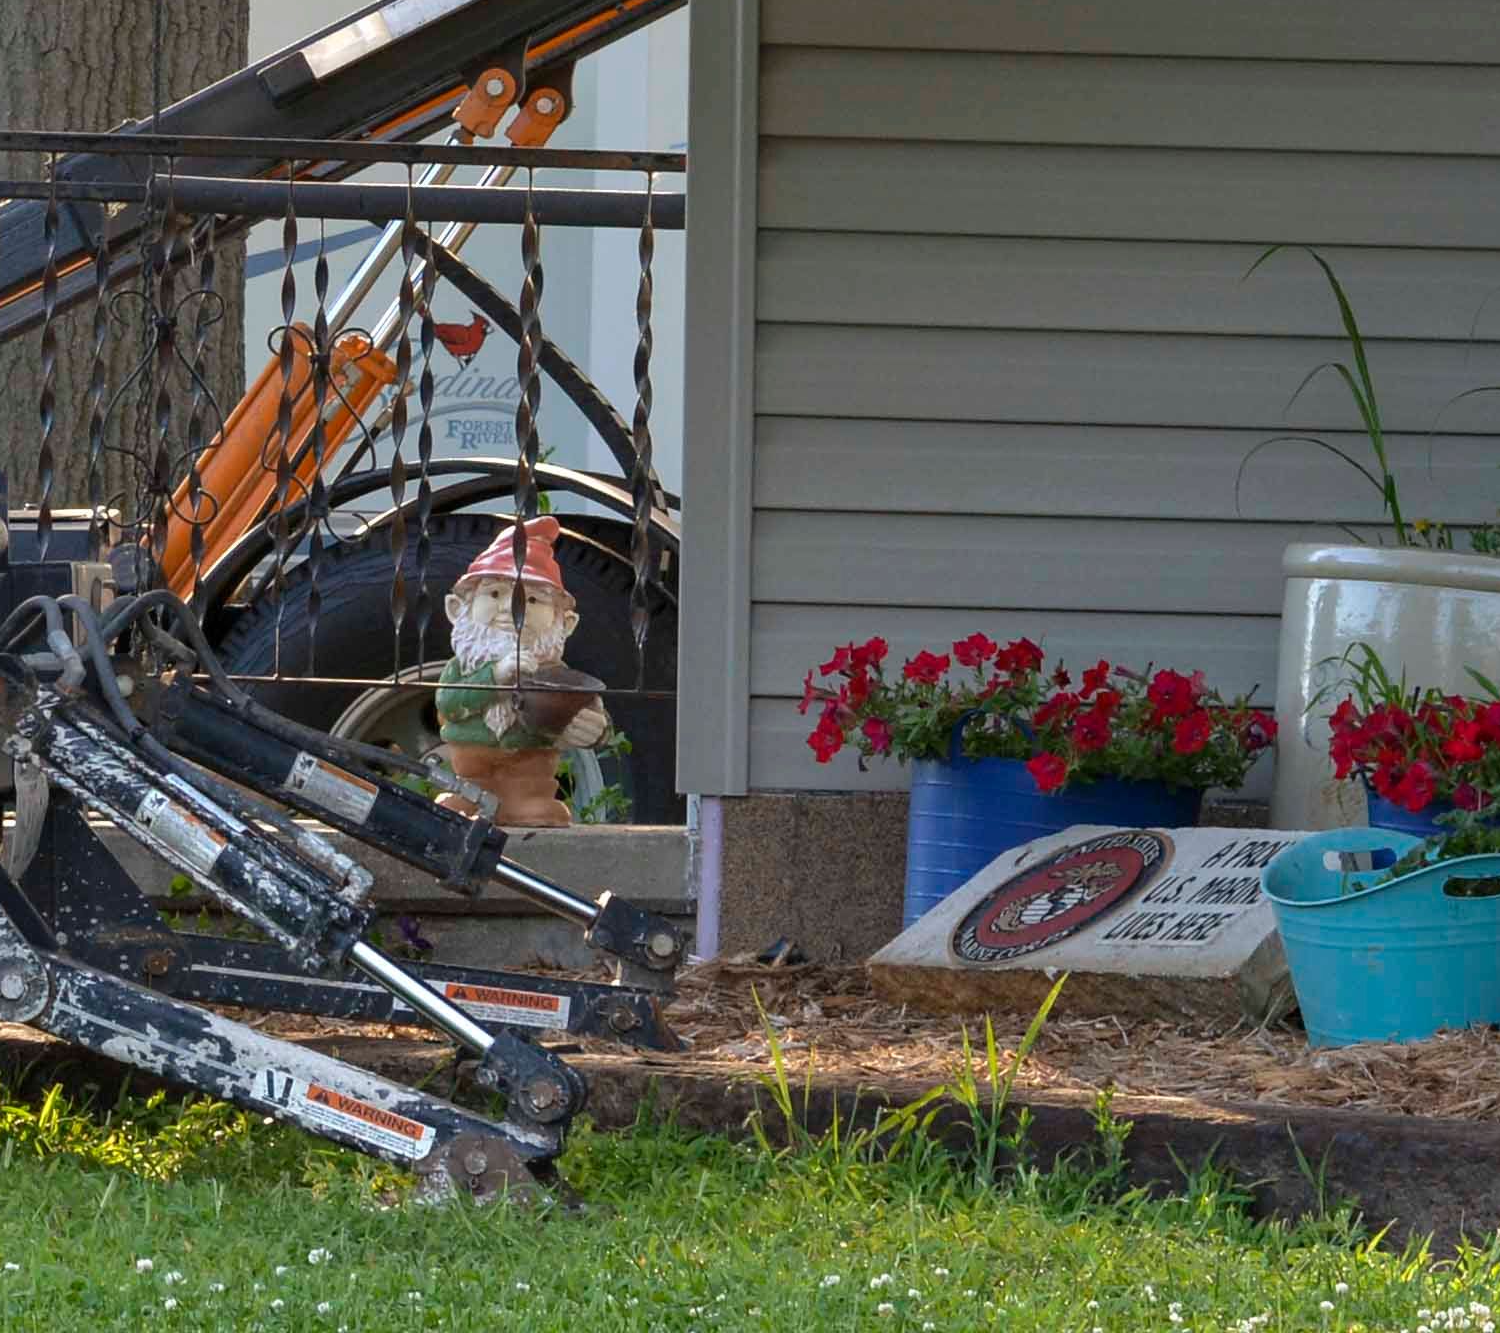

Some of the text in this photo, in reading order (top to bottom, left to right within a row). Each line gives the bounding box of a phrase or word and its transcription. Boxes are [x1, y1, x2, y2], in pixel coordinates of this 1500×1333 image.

[1201, 840, 1239, 868] A
[1142, 875, 1197, 904] U.S.
[1104, 911, 1237, 941] LIVES HERE
[475, 989, 554, 1010] WARNING
[339, 1094, 417, 1136] WARNING
